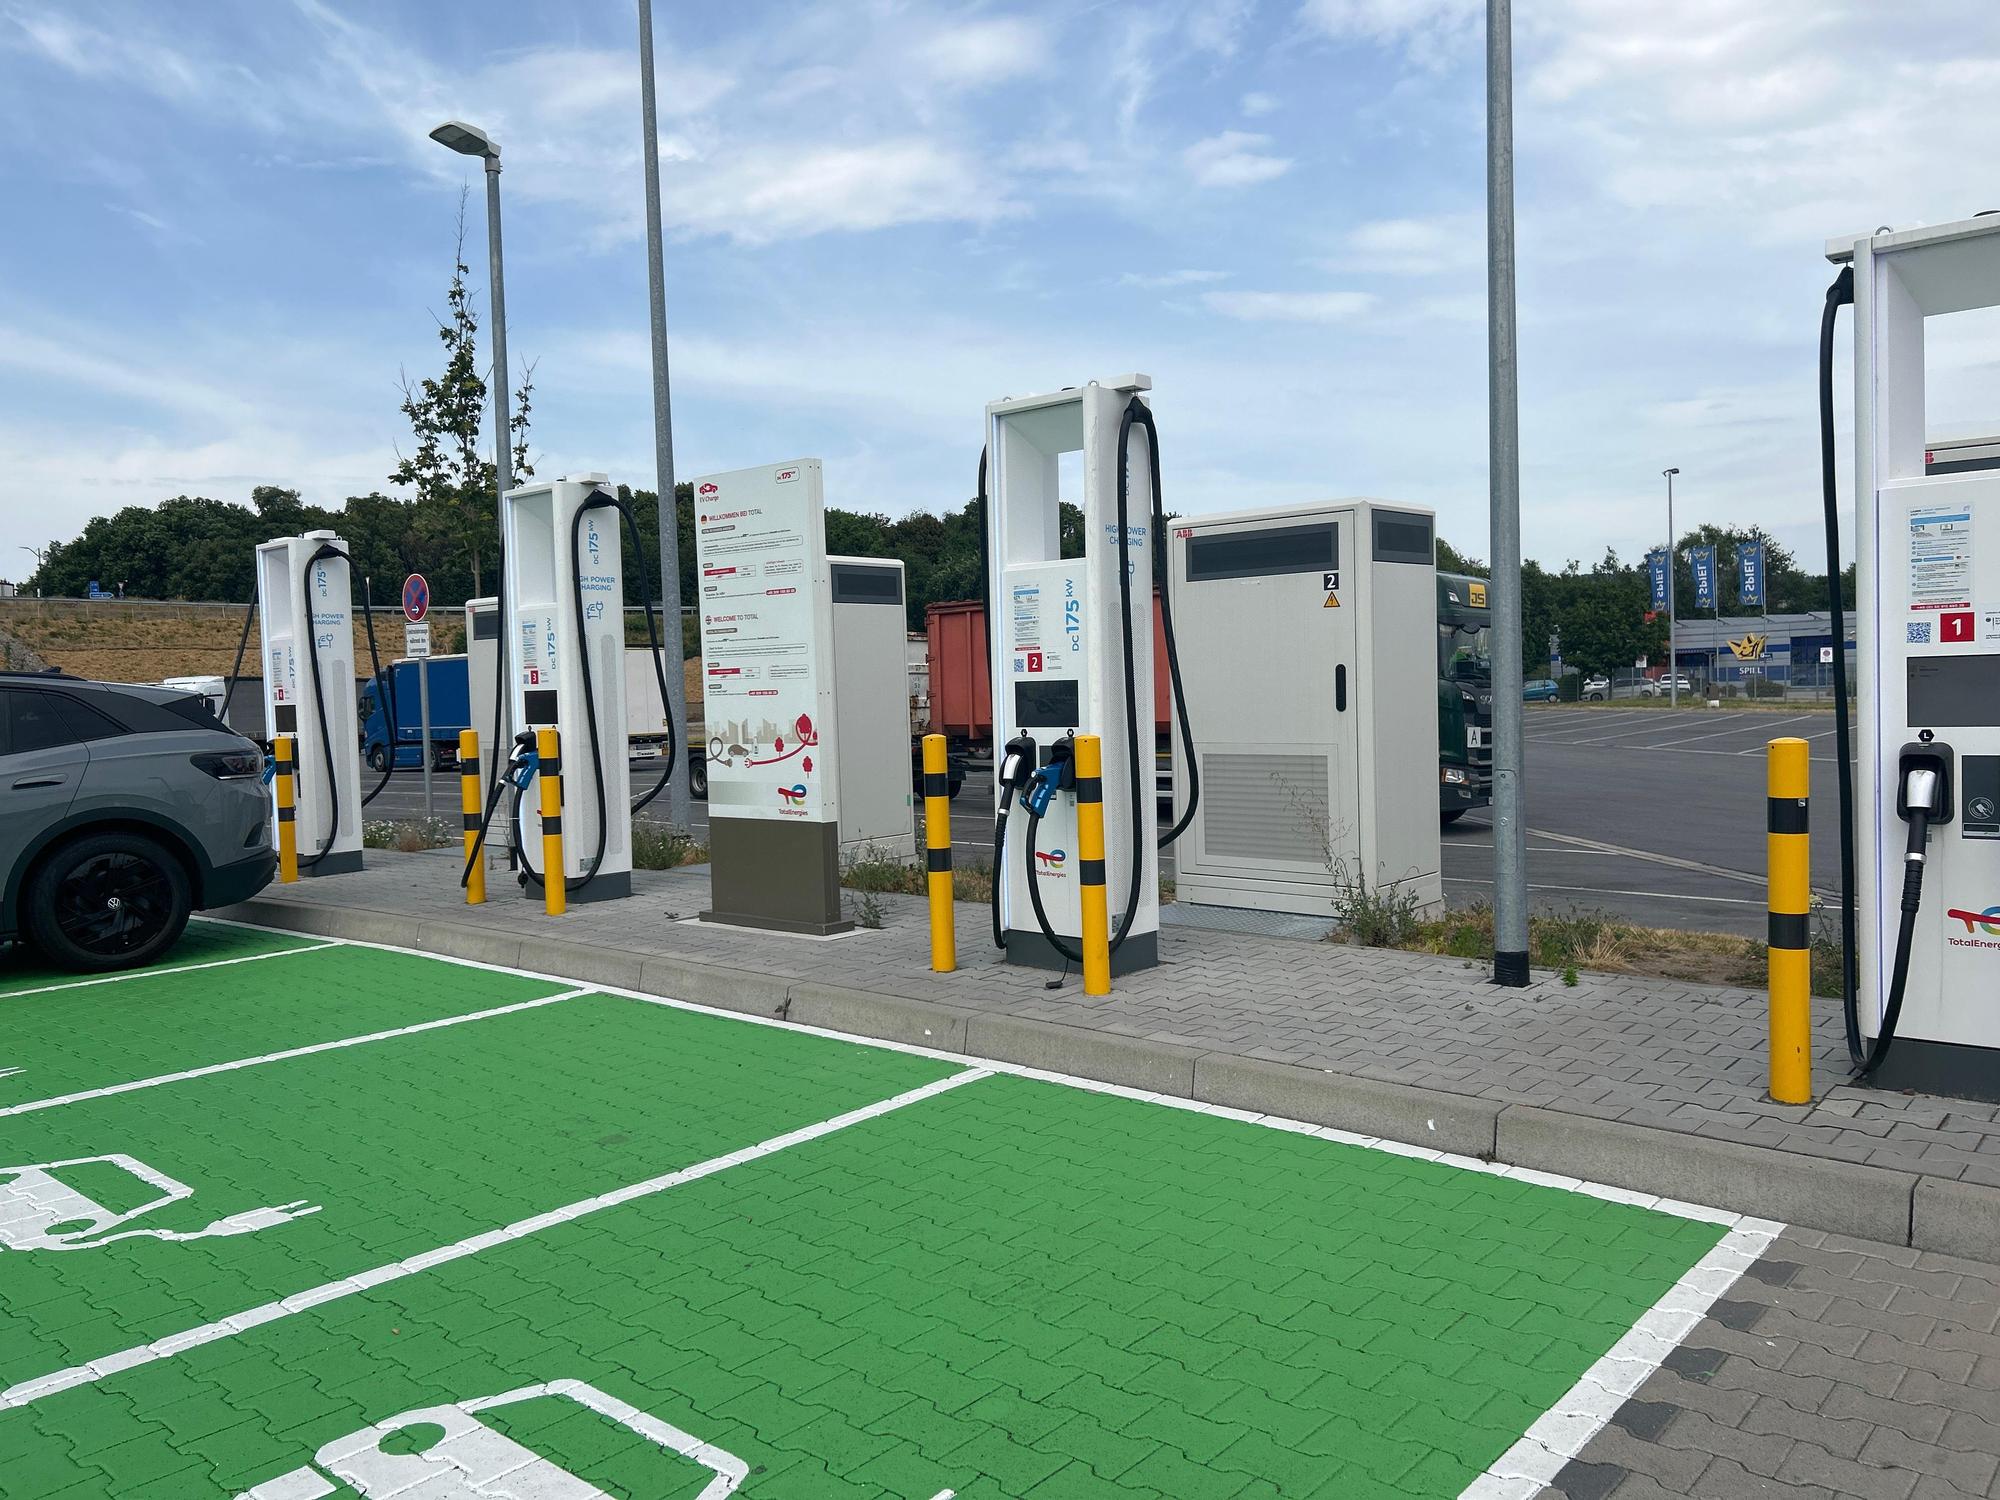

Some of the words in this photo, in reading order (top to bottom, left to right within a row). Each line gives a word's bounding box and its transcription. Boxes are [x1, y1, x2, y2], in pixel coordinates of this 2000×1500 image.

[781, 472, 792, 480] 175
[705, 495, 719, 503] Charge
[708, 511, 740, 521] WILLKOMMEN
[588, 519, 594, 531] kW
[1176, 529, 1193, 539] ABB
[588, 533, 599, 554] 175
[593, 555, 599, 565] DC
[317, 571, 327, 588] 175
[590, 576, 616, 584] POWER
[1327, 574, 1336, 589] 2
[1065, 578, 1073, 598] kW
[1471, 592, 1485, 605] JS
[1065, 599, 1080, 635] 175
[1951, 618, 1962, 636] 1
[547, 632, 556, 657] 175
[1072, 635, 1080, 651] DC
[1031, 656, 1039, 669] 2
[532, 673, 537, 682] 3
[1471, 729, 1478, 745] A
[778, 808, 808, 817] TotalEnergies
